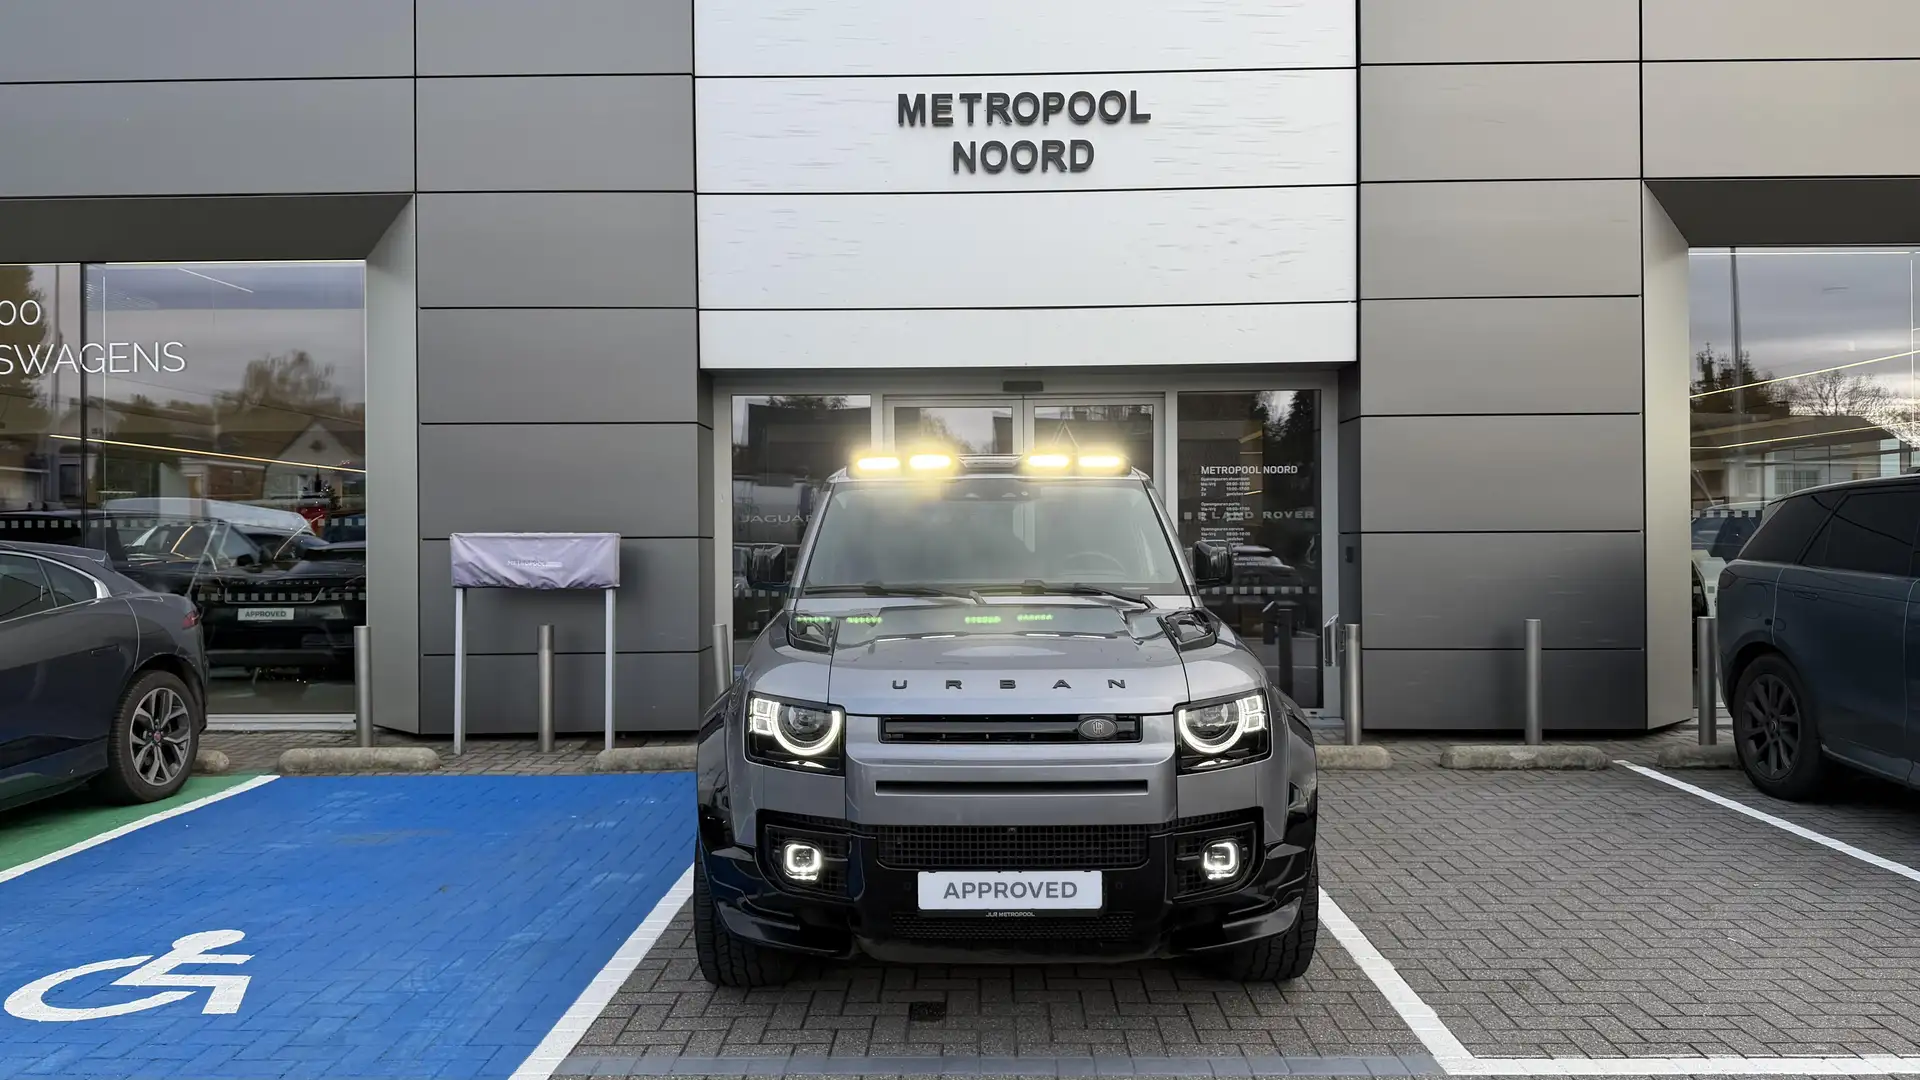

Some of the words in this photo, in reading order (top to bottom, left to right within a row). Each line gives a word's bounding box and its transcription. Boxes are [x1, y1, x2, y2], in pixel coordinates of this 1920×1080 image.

[898, 90, 1151, 126] METROPOOL
[953, 139, 1094, 173] NOORD
[0, 341, 186, 375] SWAGENS
[1201, 466, 1261, 474] METROPOOL
[1263, 465, 1298, 474] NOORD
[1262, 511, 1314, 519] ROVER
[892, 679, 1126, 689] URBAN
[943, 881, 1078, 899] APPROVED
